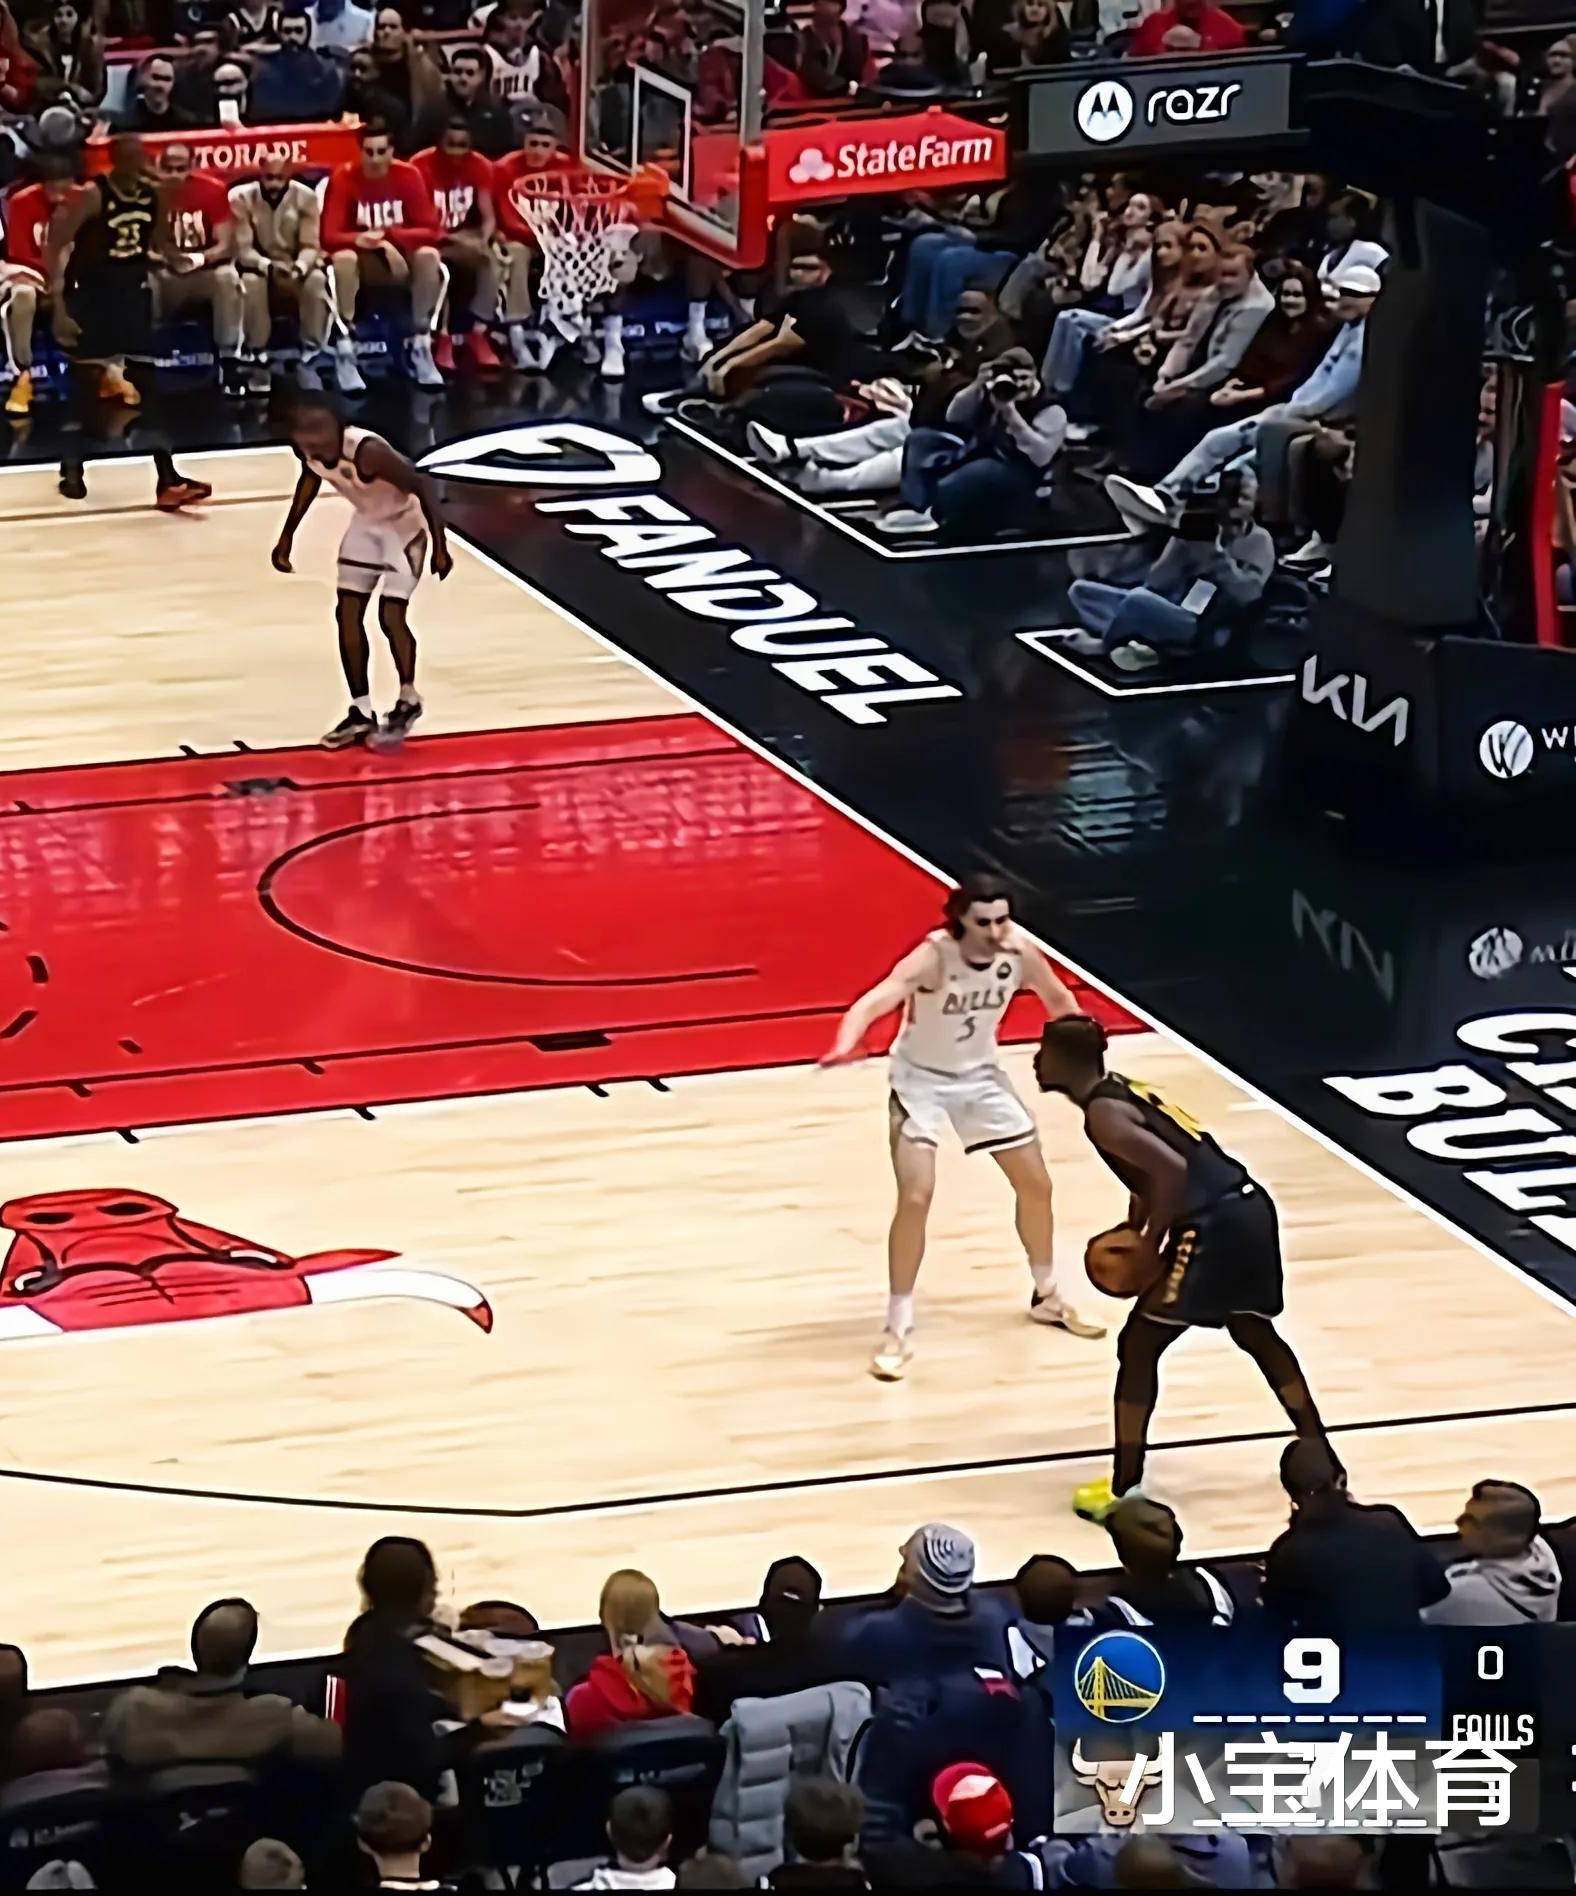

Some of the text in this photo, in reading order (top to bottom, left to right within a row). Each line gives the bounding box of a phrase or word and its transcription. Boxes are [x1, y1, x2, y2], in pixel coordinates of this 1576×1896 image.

[1147, 83, 1242, 123] razr
[193, 140, 308, 170] TORADE
[533, 493, 965, 726] FANDUEL
